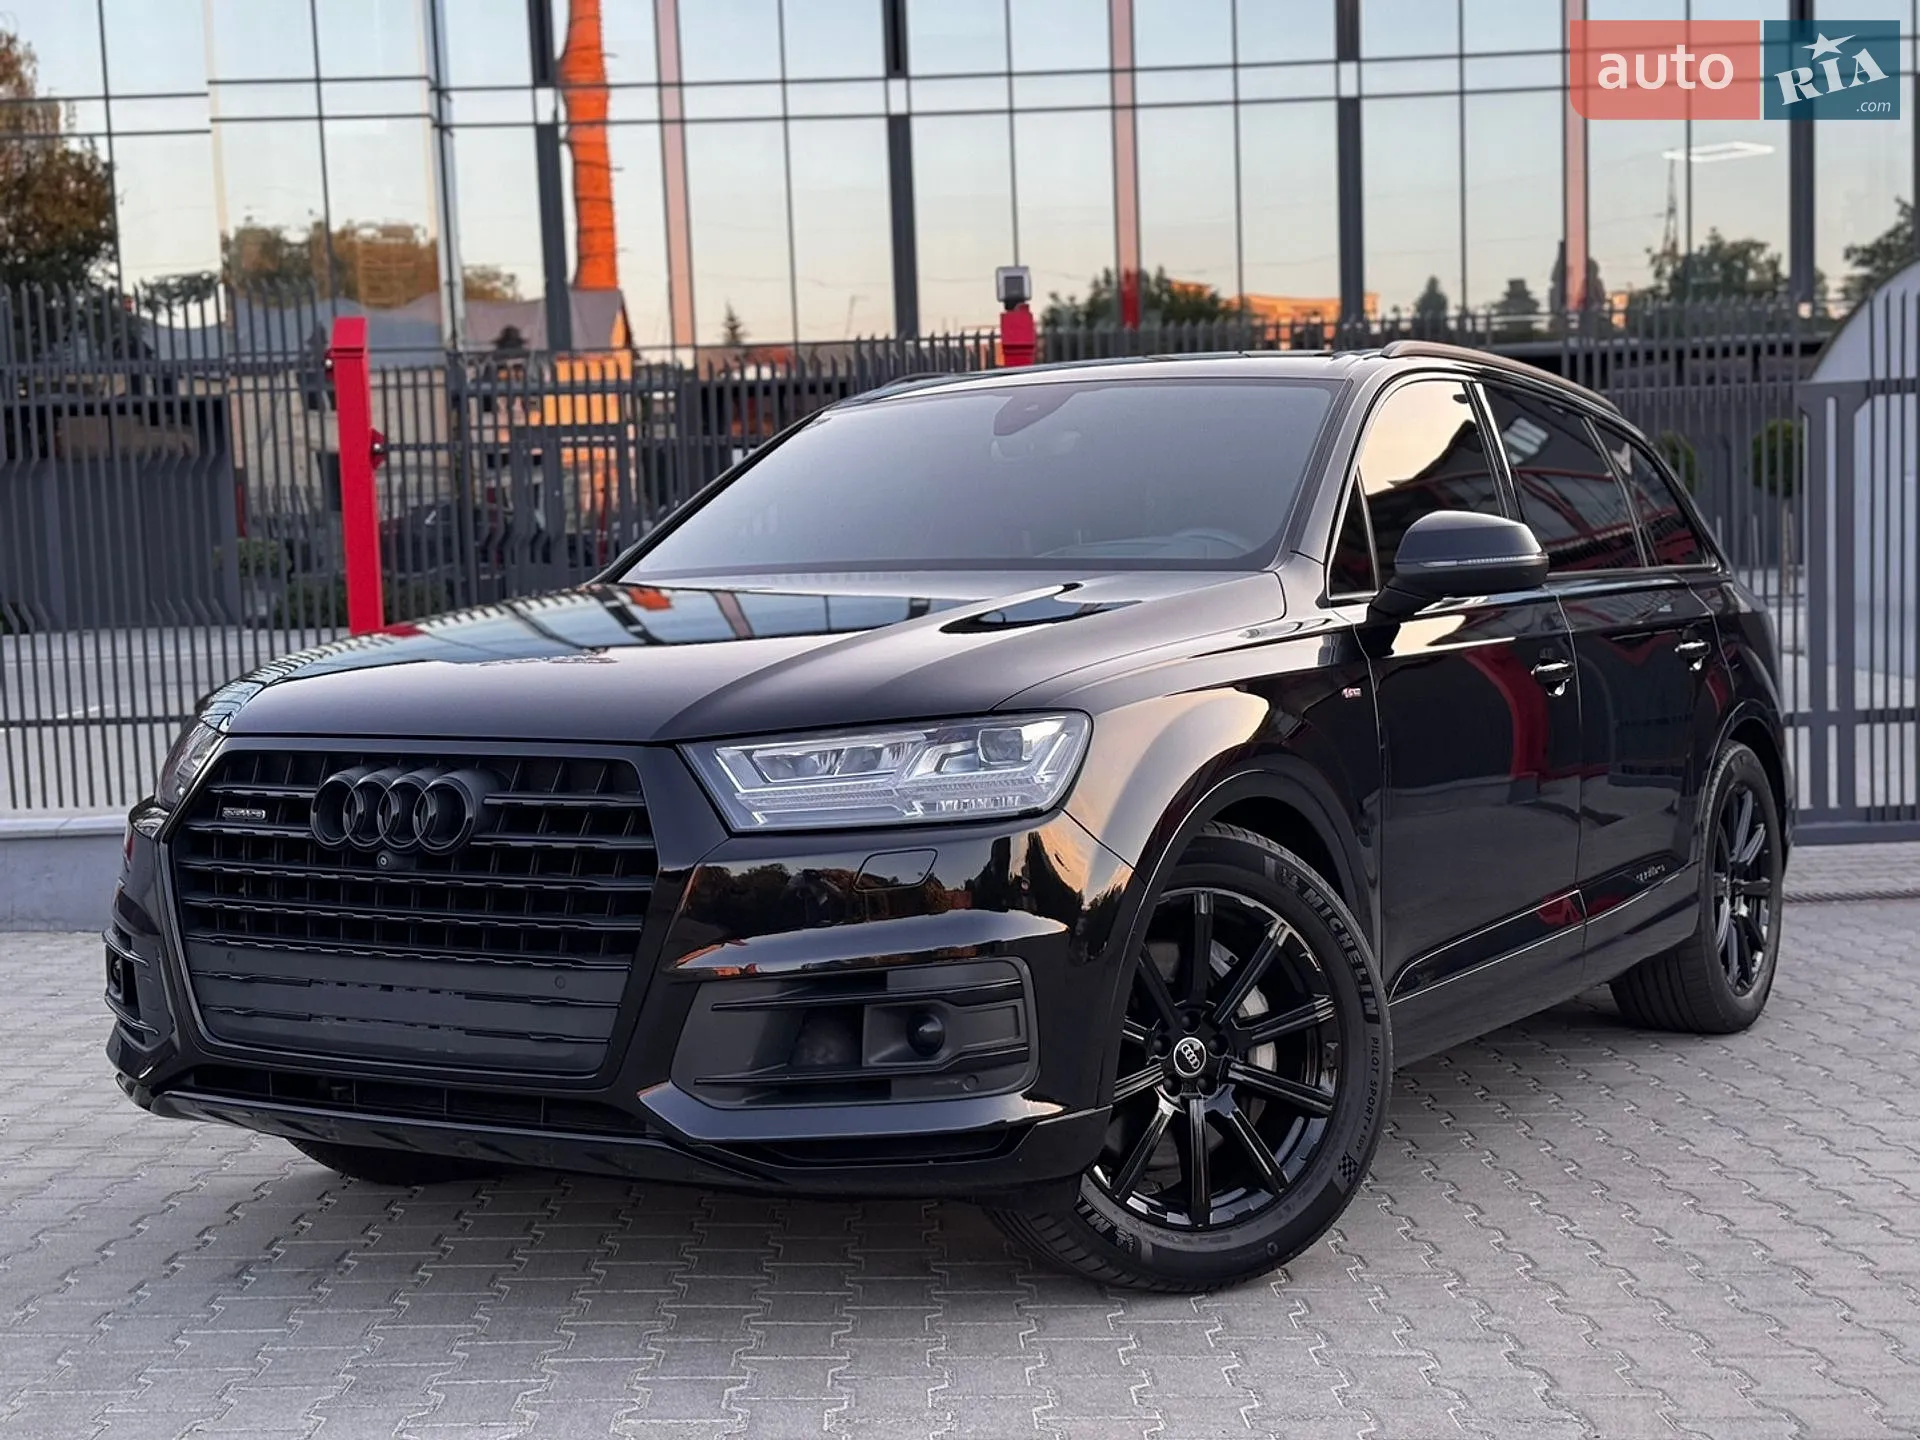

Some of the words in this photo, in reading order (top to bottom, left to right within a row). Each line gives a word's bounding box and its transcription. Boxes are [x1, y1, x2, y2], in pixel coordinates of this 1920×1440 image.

[1303, 887, 1379, 1015] MICHELIN
[1371, 1036, 1380, 1075] PILOT
[1363, 1079, 1378, 1125] SPORT
